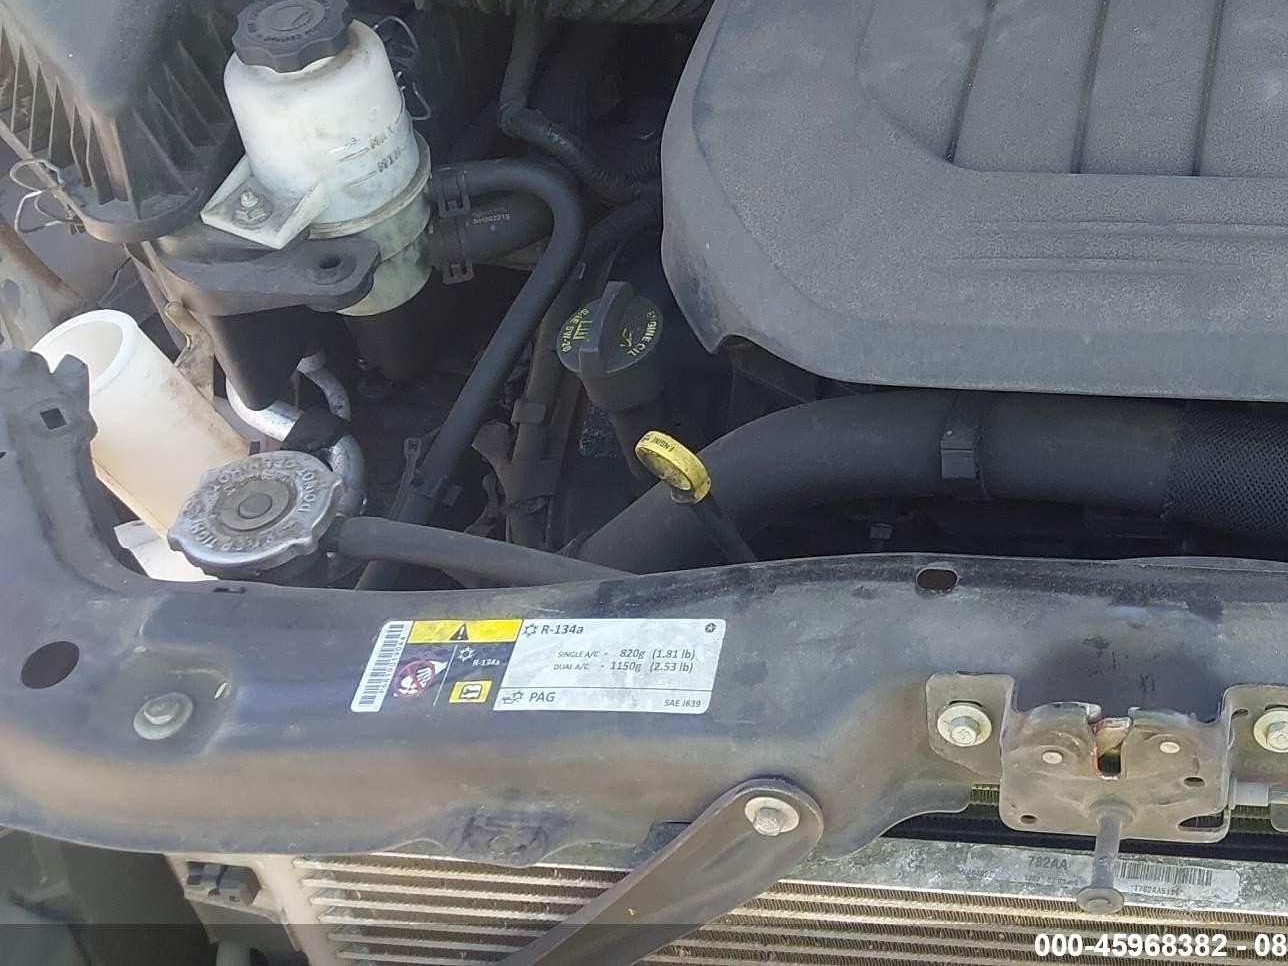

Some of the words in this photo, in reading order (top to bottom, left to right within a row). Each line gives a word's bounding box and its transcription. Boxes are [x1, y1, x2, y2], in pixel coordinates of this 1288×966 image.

[540, 623, 584, 635] R-134a
[587, 650, 601, 658] A/C
[619, 648, 645, 661] 820g
[652, 648, 679, 661] (1.81
[681, 648, 696, 661] lb)
[472, 659, 500, 667] R-134a
[553, 662, 573, 671] DUAL
[609, 661, 641, 673] 1150g
[649, 661, 677, 674] (2.53
[678, 661, 694, 674] lb)
[529, 691, 556, 703] PAG
[664, 699, 681, 707] SAE
[682, 699, 701, 708] J639
[1027, 855, 1068, 870] 782AA
